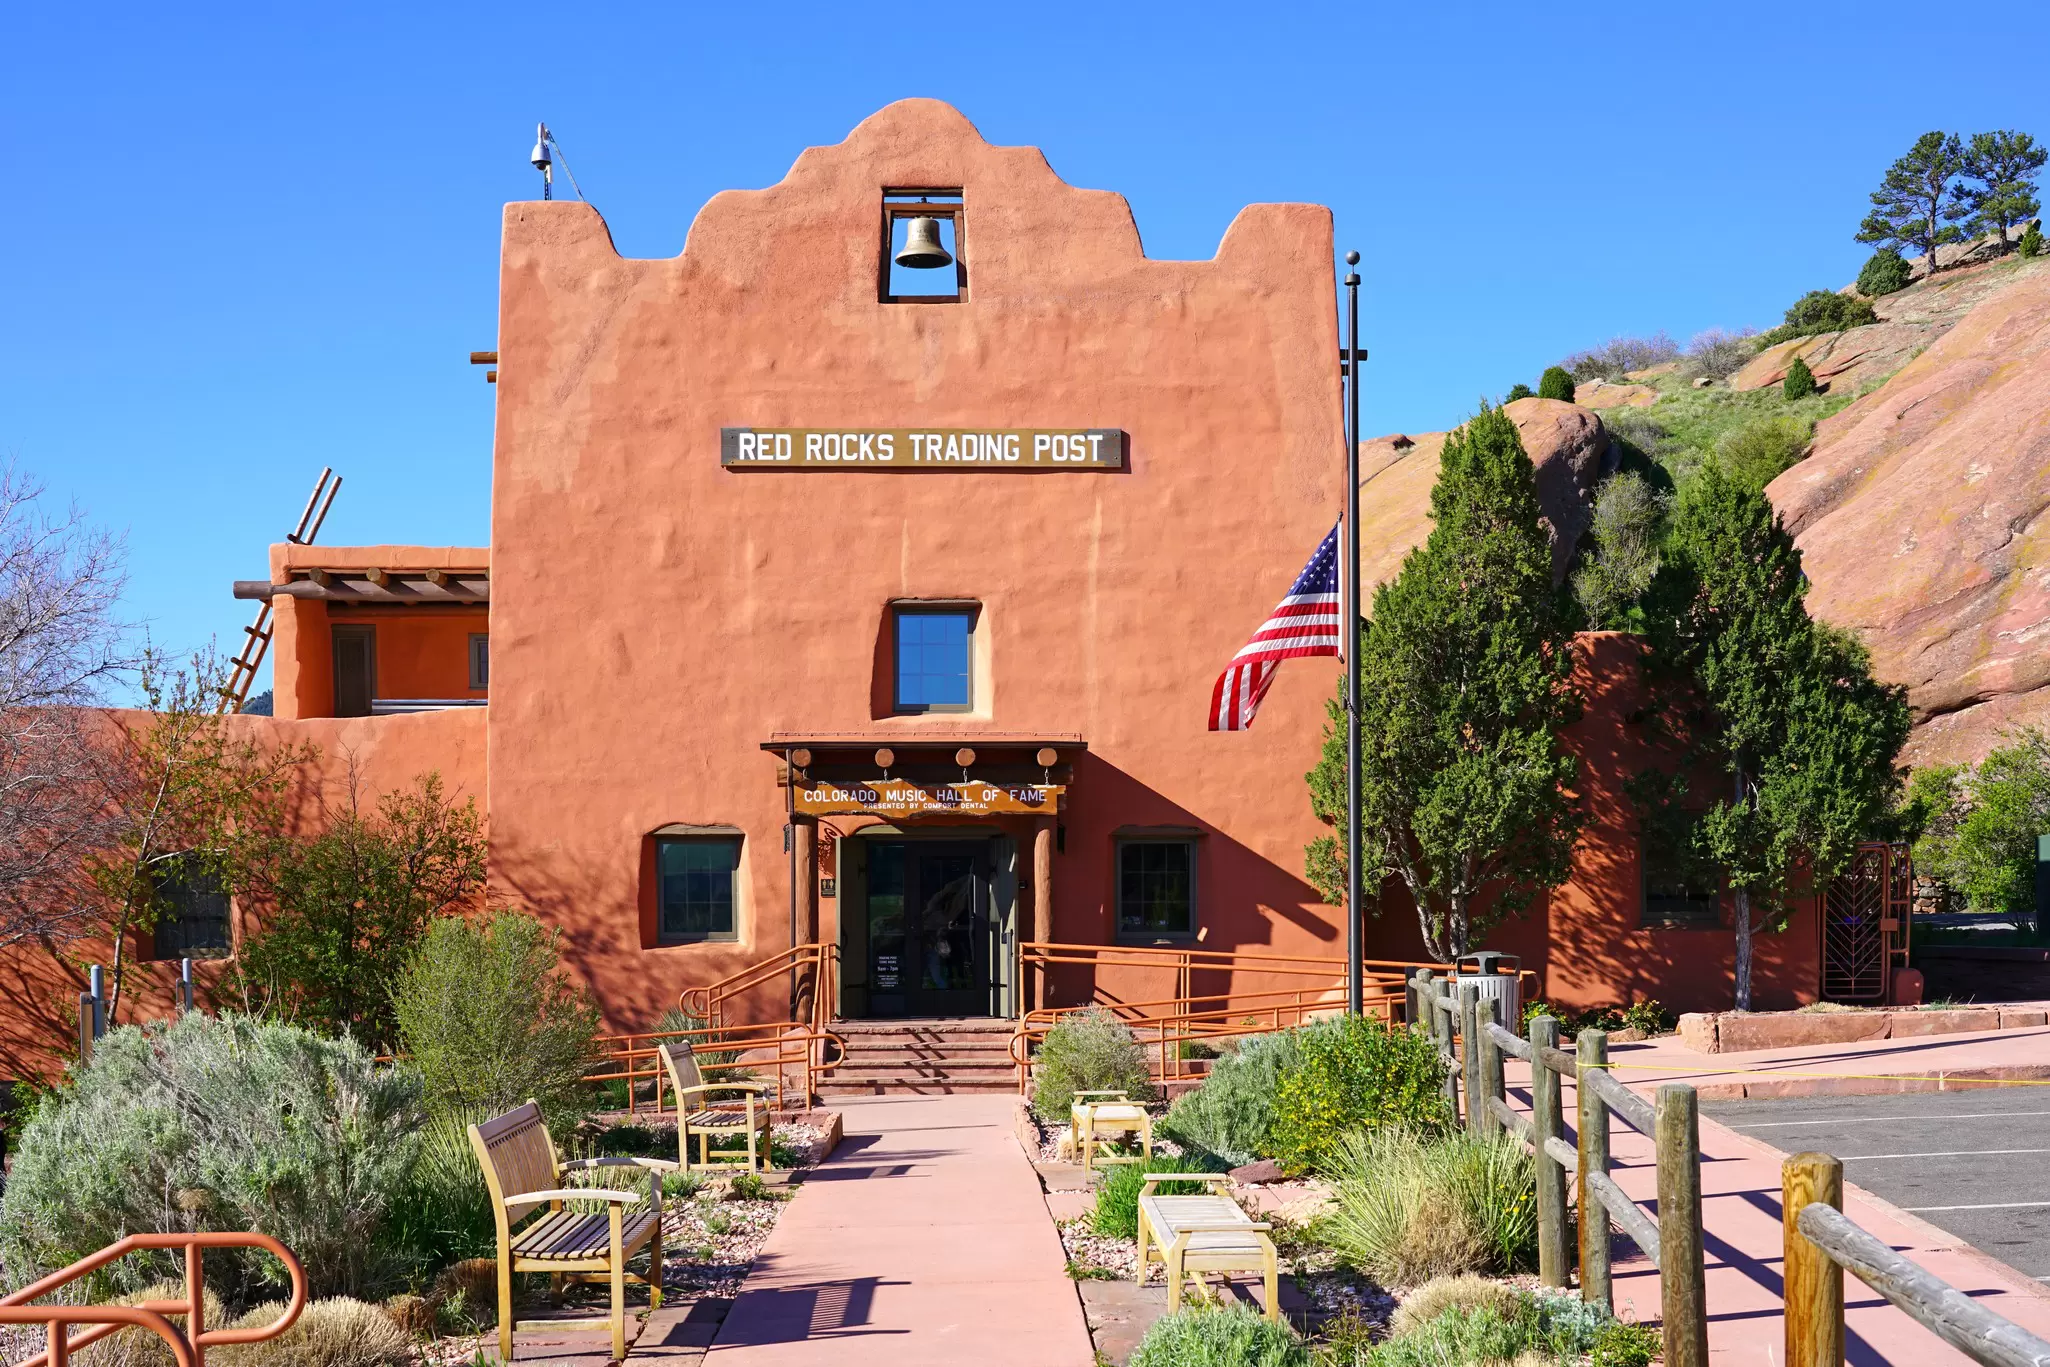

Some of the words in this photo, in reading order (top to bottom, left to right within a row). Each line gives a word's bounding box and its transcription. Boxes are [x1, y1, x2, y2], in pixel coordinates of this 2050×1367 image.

[738, 433, 792, 461] RED
[805, 433, 894, 461] ROCKS
[909, 433, 1020, 461] TRADING
[1033, 433, 1103, 461] POST
[803, 789, 876, 802] COLORADO
[886, 789, 927, 802] MUSIC
[936, 789, 973, 802] HALL
[982, 789, 1001, 802] OF
[1009, 789, 1048, 802] FAME
[863, 802, 905, 810] PRESENTED
[909, 802, 919, 810] BY
[923, 802, 956, 810] COMFORT
[961, 802, 989, 810] DENTAL
